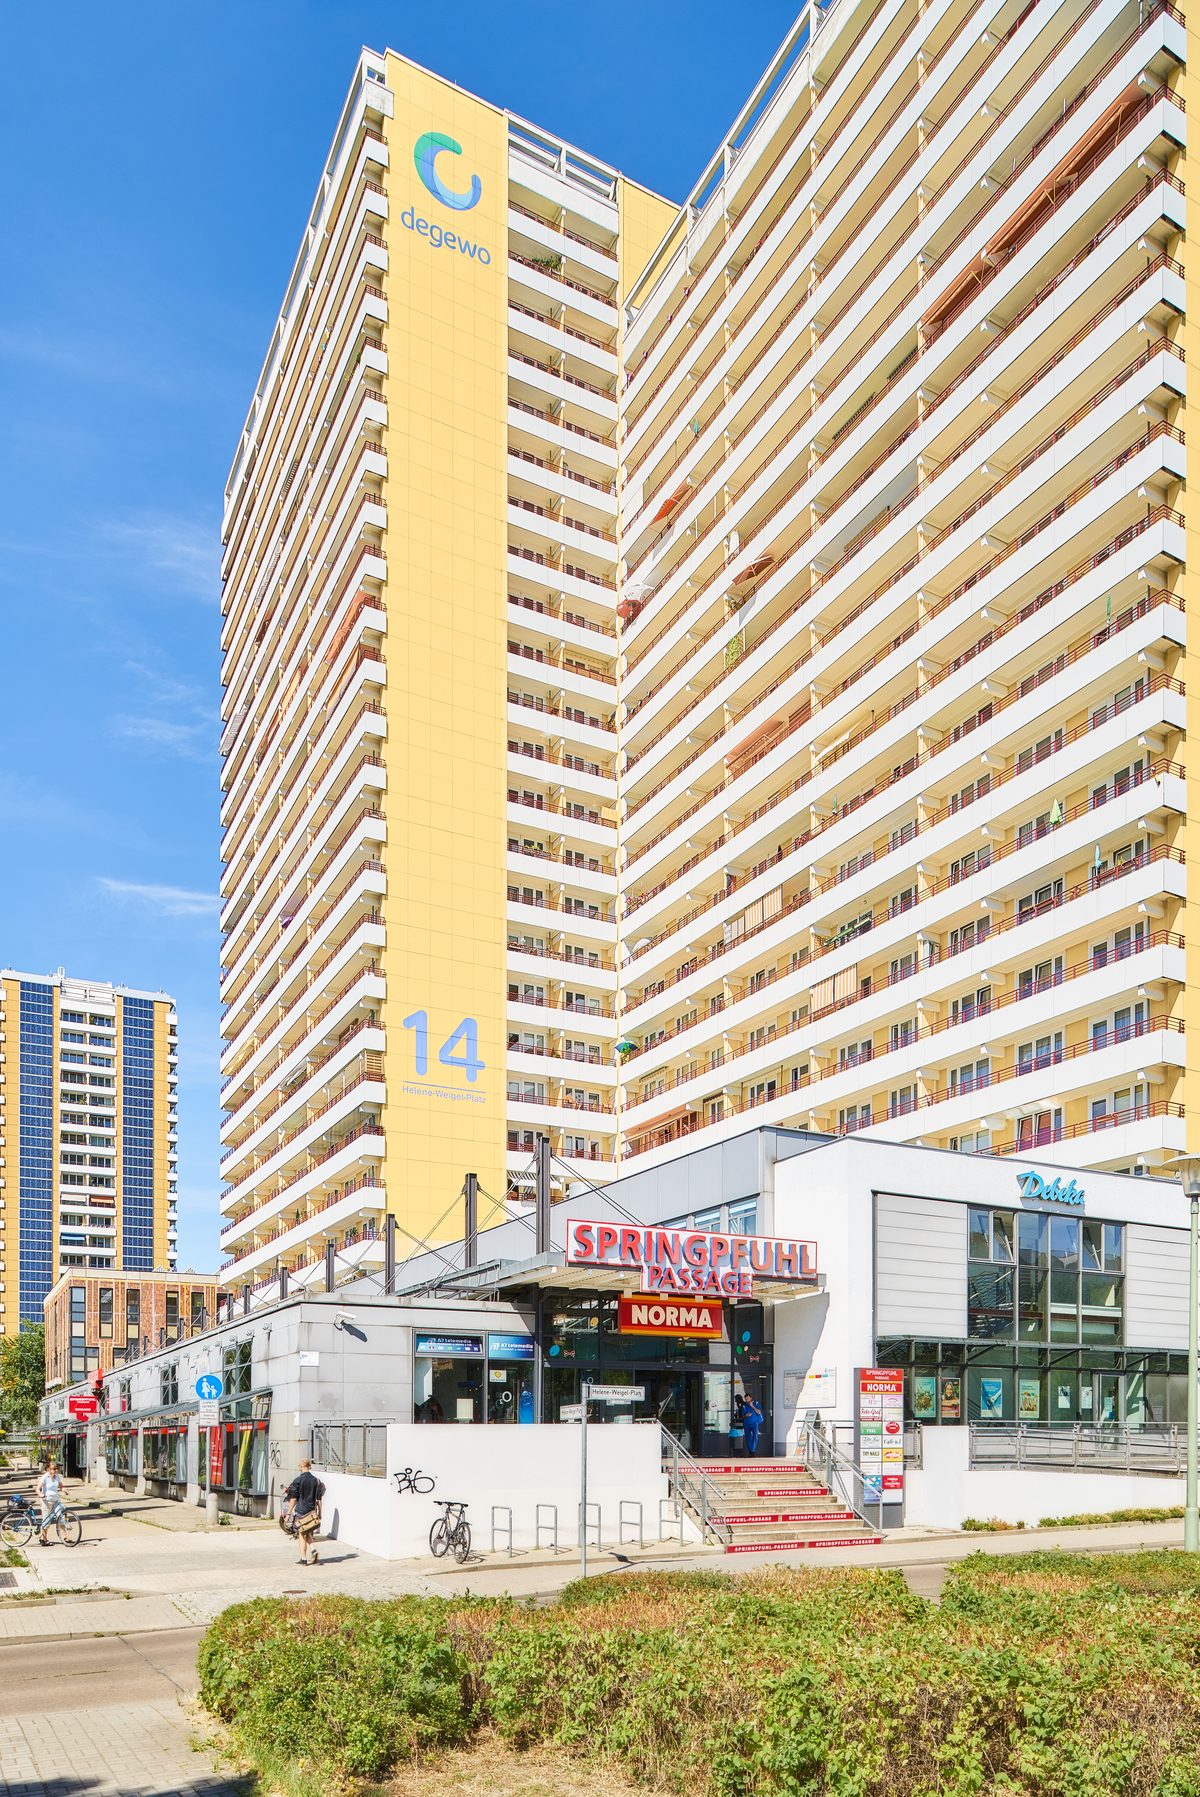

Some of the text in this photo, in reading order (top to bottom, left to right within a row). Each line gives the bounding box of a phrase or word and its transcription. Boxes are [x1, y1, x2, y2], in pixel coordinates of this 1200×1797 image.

[400, 206, 491, 265] degewo
[402, 1009, 486, 1083] 14
[402, 1085, 487, 1104] Helene-Weigel-Platz
[1016, 1170, 1085, 1206] Debeka
[573, 1224, 818, 1275] SPRINGPFUHL
[647, 1265, 752, 1294] PASSAGE
[631, 1304, 713, 1328] NORMA
[592, 1388, 642, 1397] Helene-Weigel-Platz
[866, 1383, 897, 1392] NORMA
[734, 1543, 799, 1551] SPRINGPFUHL-PASSAGE
[815, 1539, 876, 1547] SPRINGPFUHL-PASSAGE
